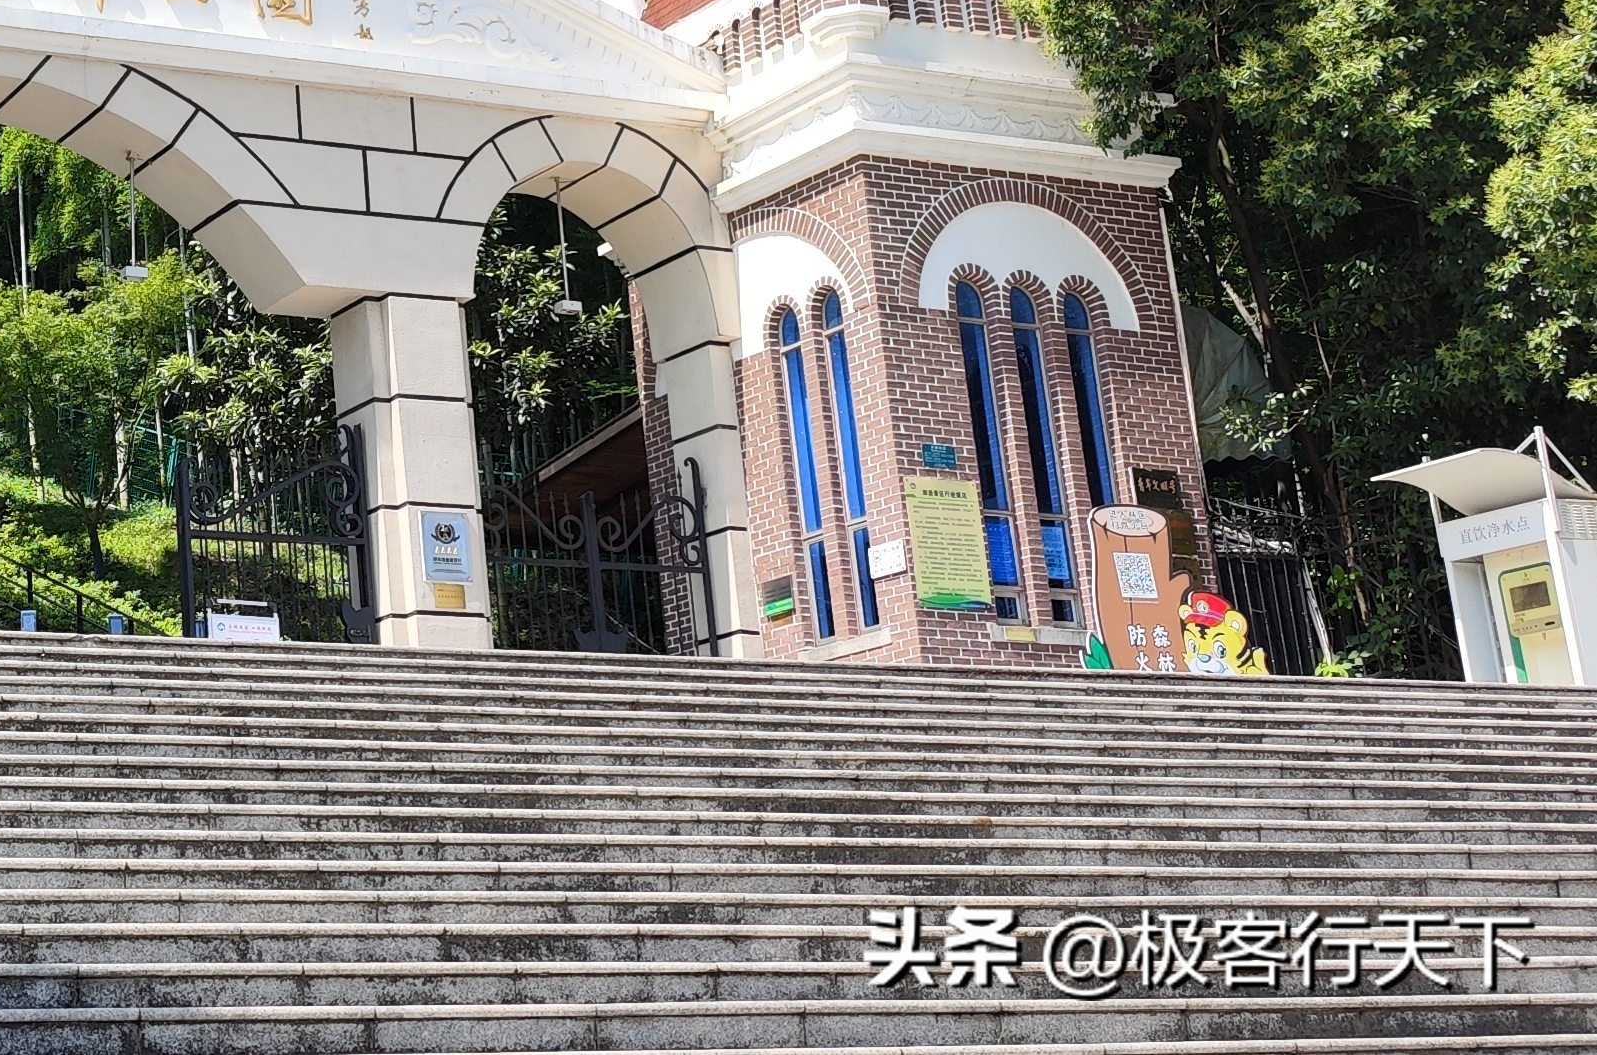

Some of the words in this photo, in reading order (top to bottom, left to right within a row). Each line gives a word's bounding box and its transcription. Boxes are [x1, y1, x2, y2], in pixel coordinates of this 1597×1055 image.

[1460, 515, 1530, 544] 直饮净水点
